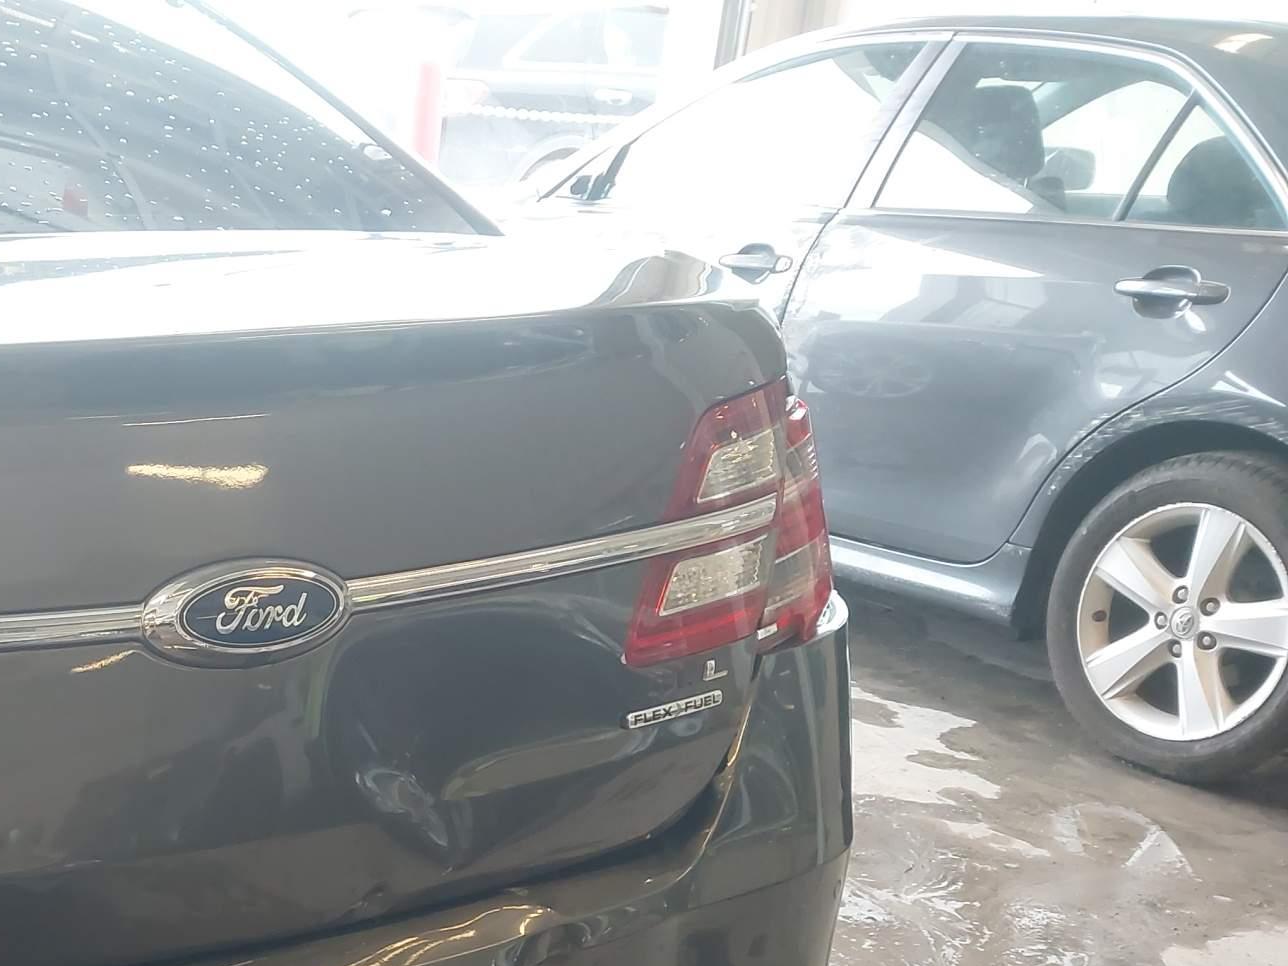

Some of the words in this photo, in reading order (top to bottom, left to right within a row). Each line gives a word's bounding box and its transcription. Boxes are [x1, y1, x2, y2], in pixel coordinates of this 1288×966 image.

[216, 585, 307, 634] Ford
[633, 706, 672, 726] FLEX
[684, 693, 721, 712] FUEL
